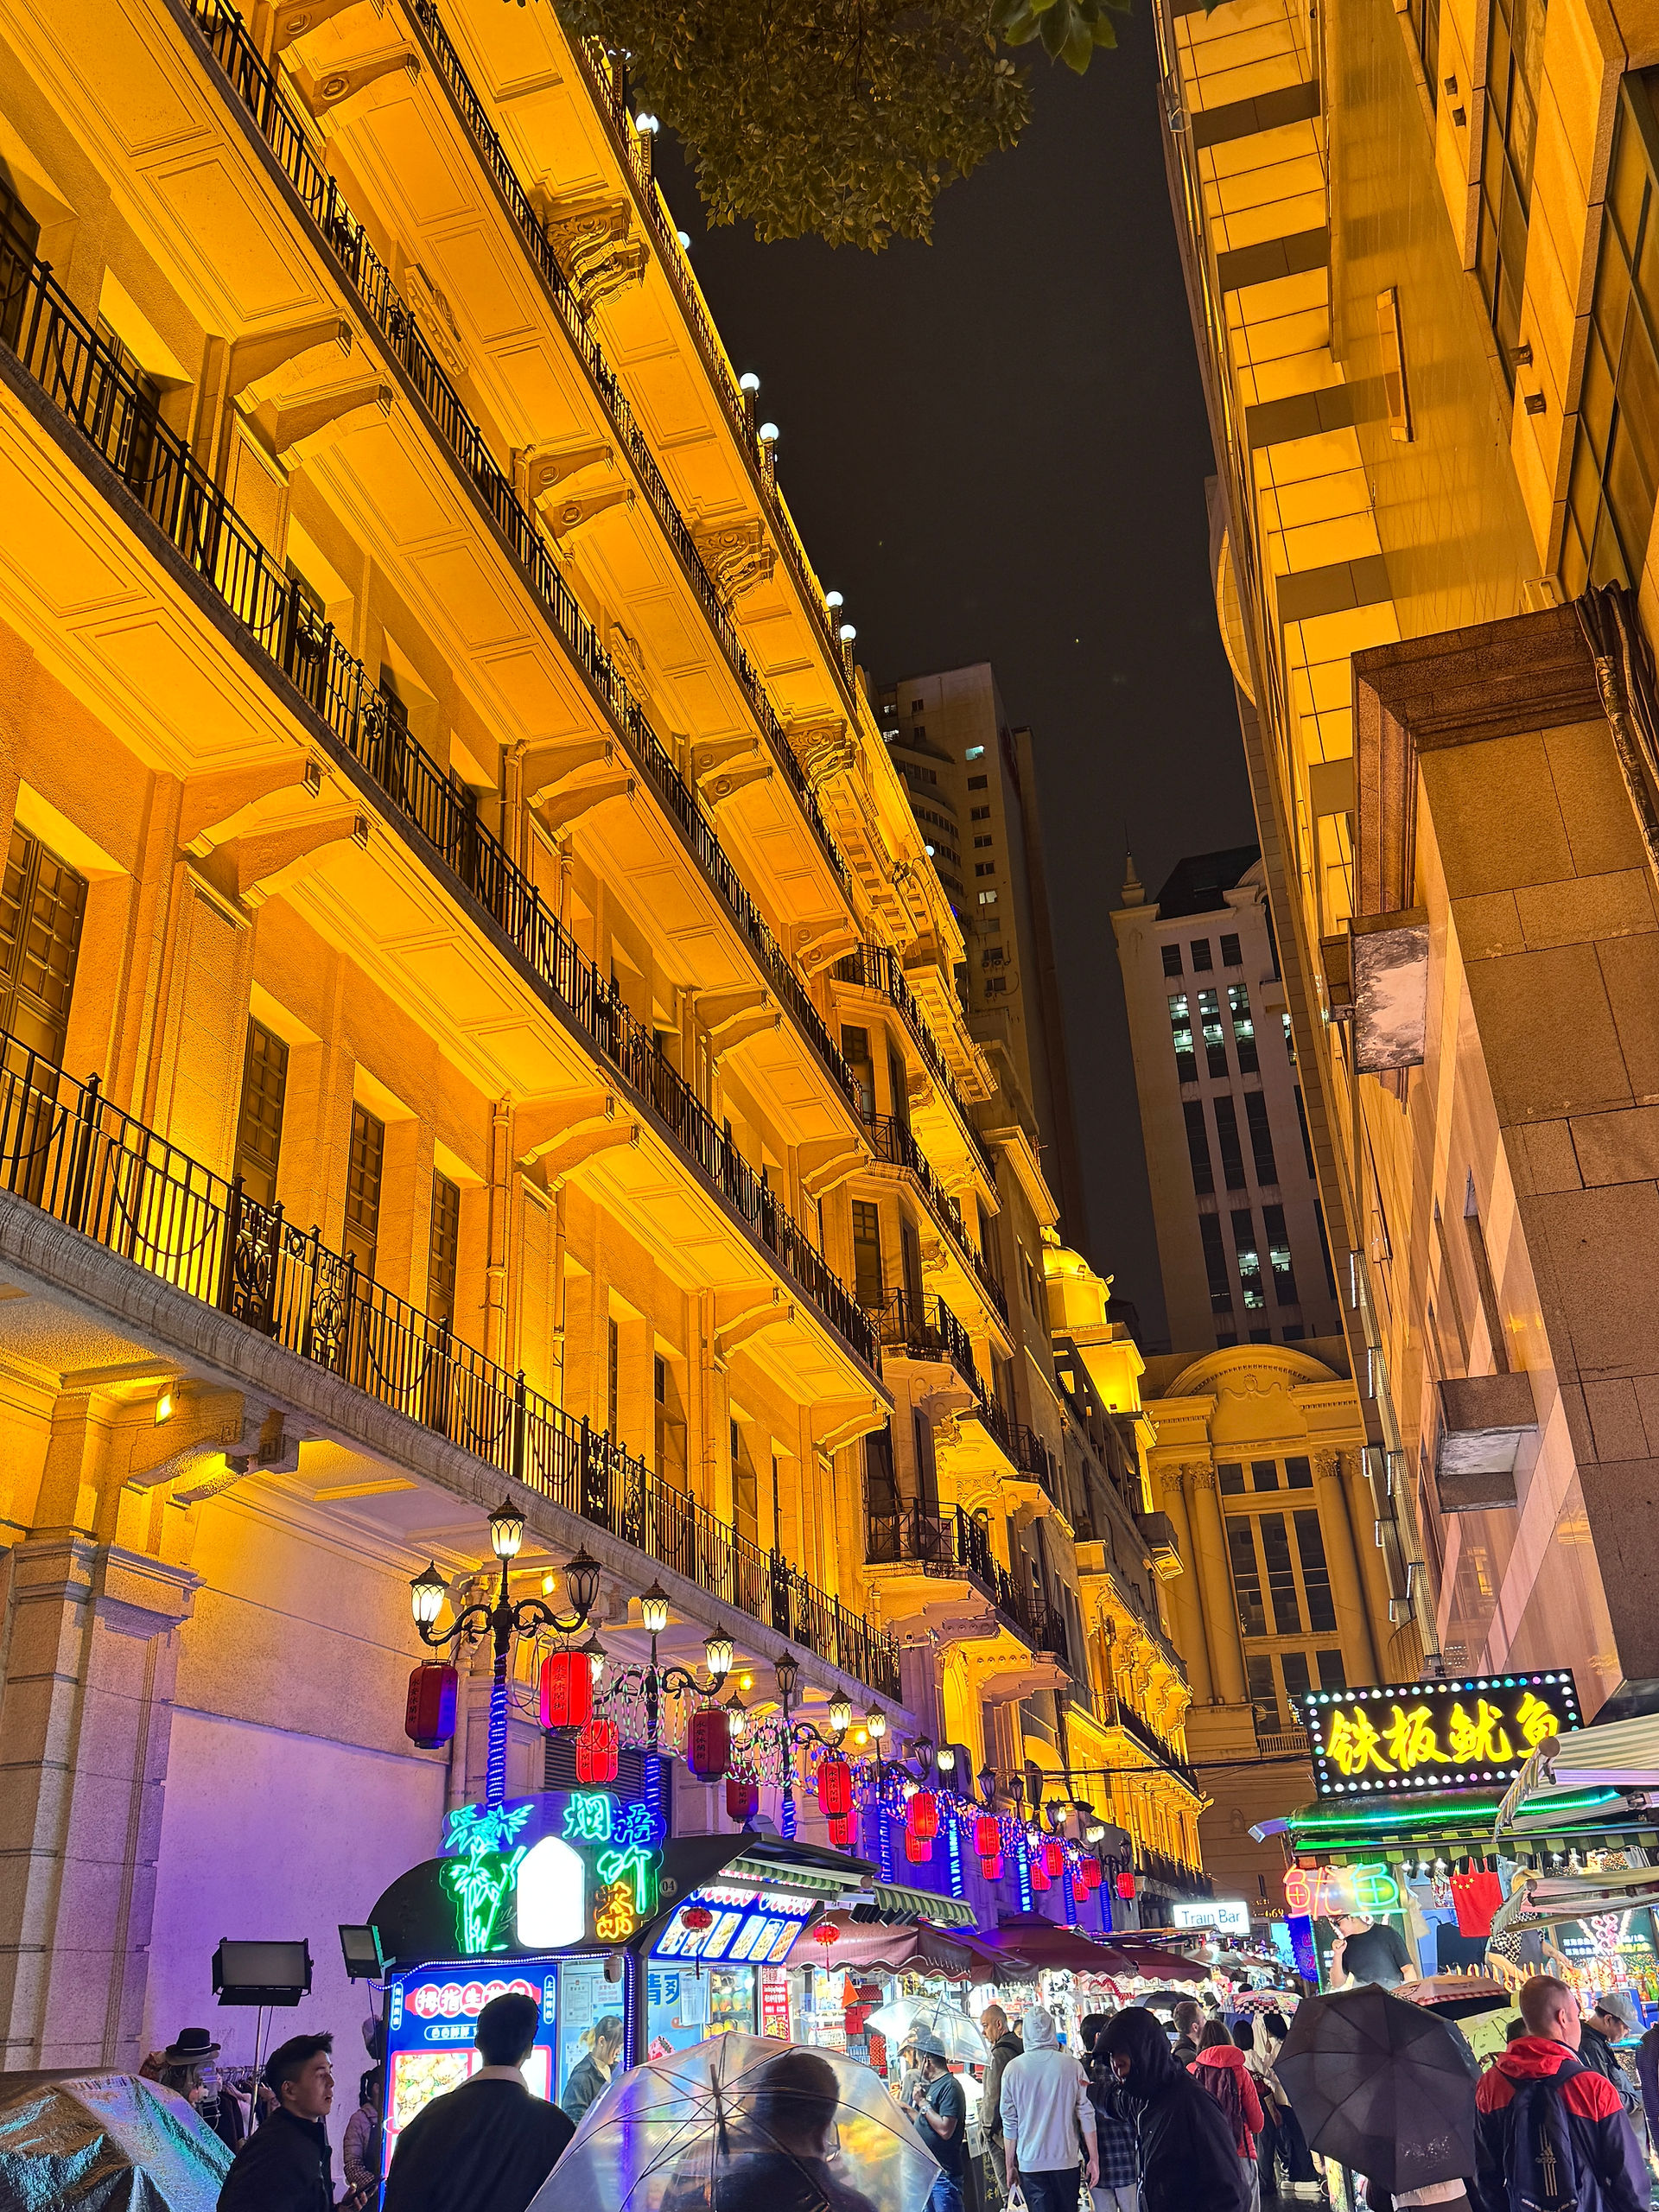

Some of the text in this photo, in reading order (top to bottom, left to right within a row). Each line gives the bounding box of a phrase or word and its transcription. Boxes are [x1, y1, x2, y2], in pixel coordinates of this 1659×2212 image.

[1326, 1691, 1560, 1776] 铁板鱿鱼
[662, 1881, 675, 1891] 04
[1283, 1863, 1408, 1921] 鱿鱼
[1181, 1909, 1241, 1926] Train Bar
[417, 1986, 526, 2012] 拇指生
